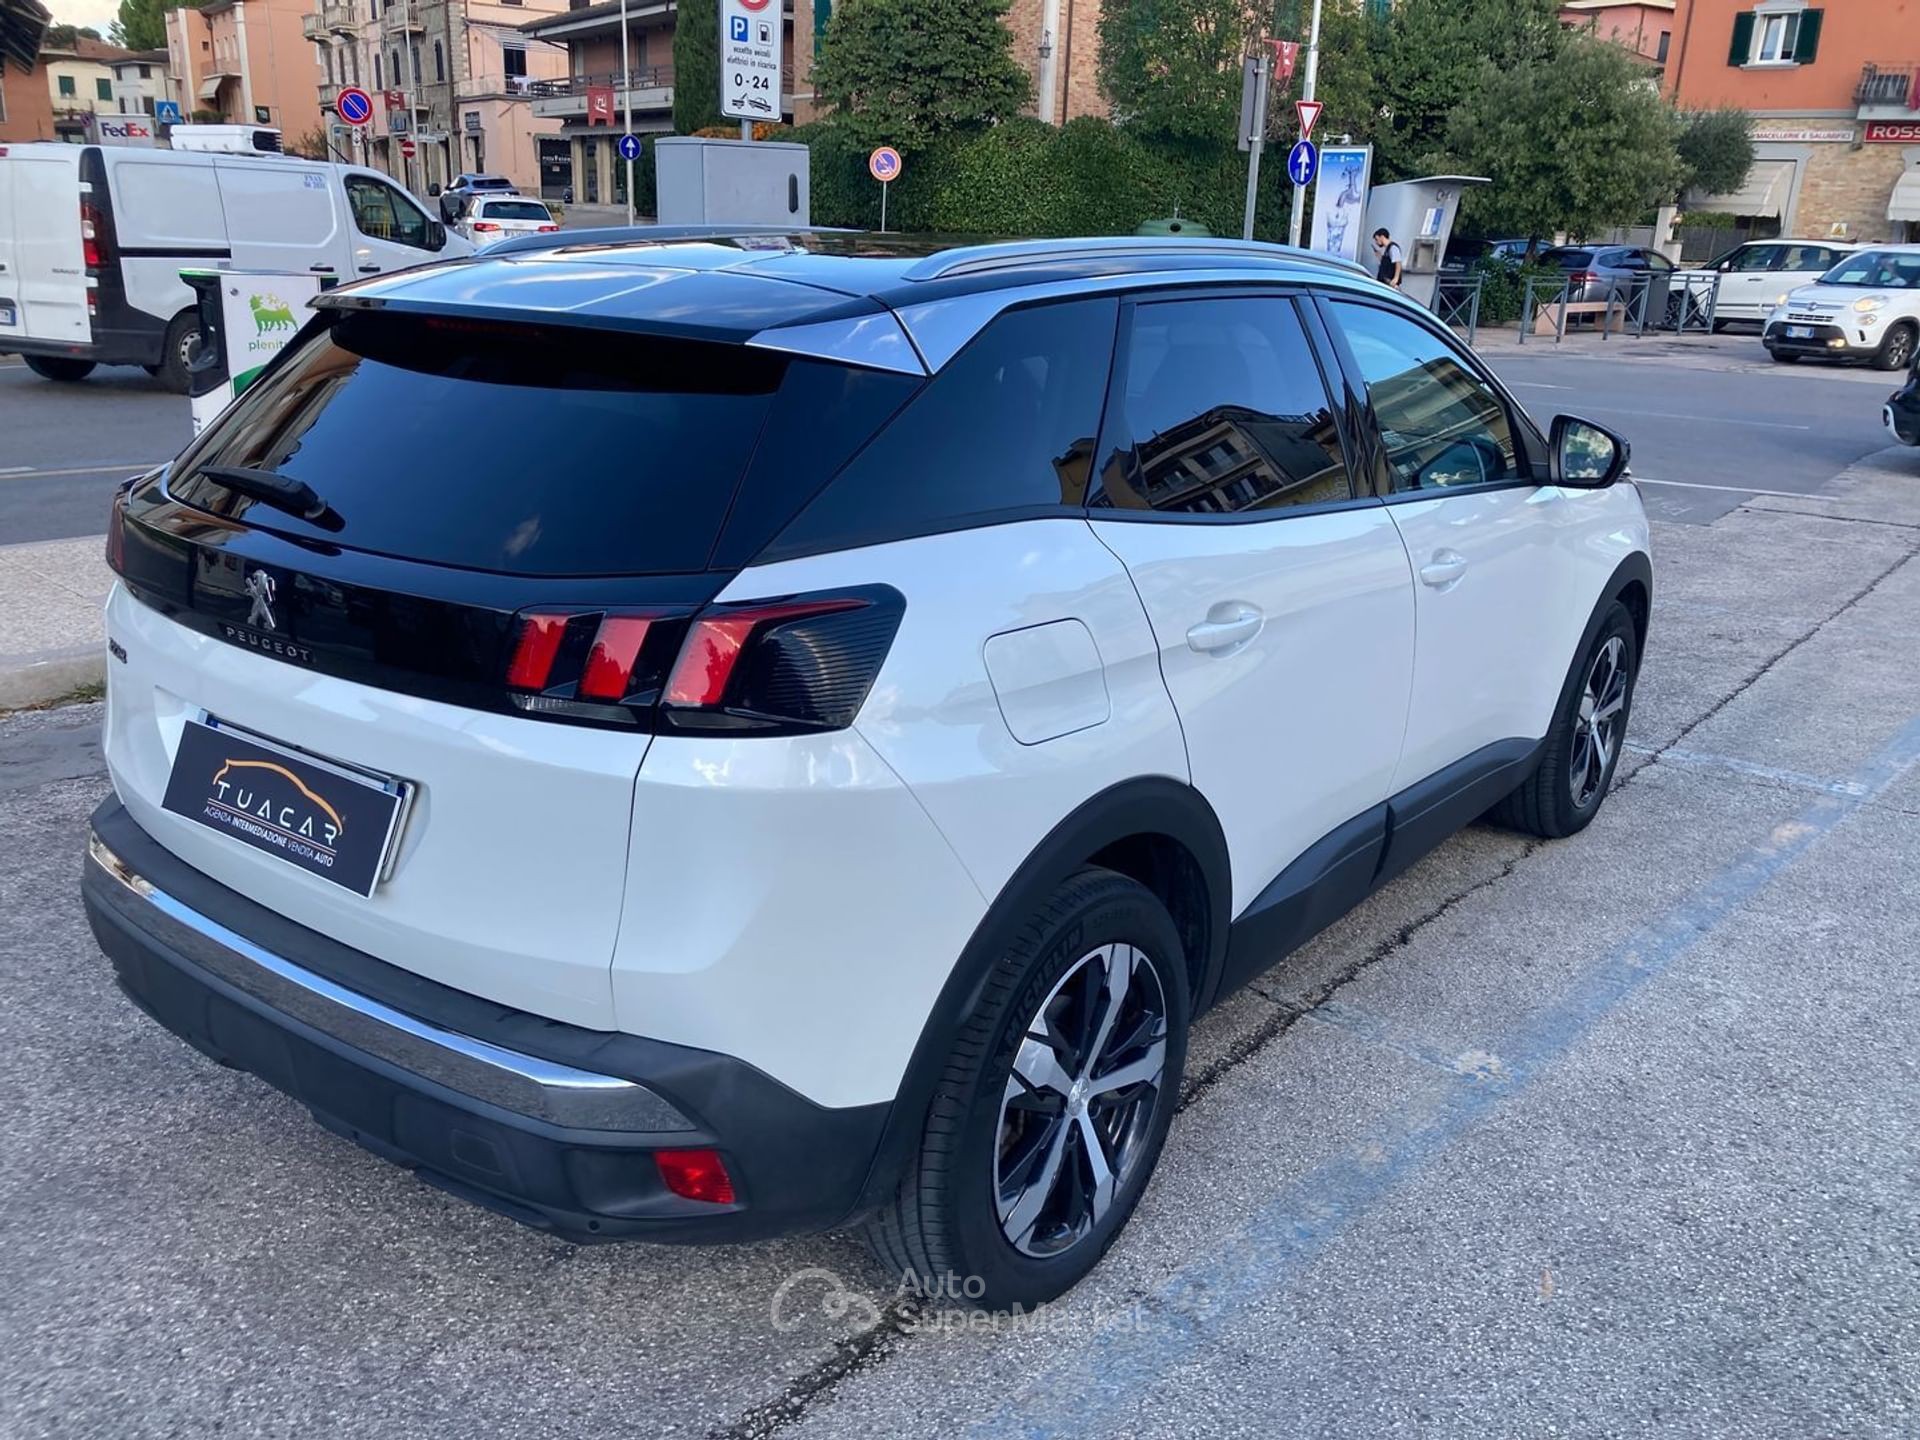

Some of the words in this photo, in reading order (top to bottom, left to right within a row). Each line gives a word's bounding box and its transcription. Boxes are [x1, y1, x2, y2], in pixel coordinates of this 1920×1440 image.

[734, 18, 745, 39] P
[101, 122, 149, 137] FedEx
[248, 339, 288, 352] plenit
[226, 626, 310, 661] PEUGEOT
[218, 780, 337, 845] TUACAR
[203, 806, 231, 823] AGENZIA
[231, 816, 288, 847] INTERMEDIAZIONE
[287, 840, 314, 859] VENDITA
[314, 852, 334, 867] AUTO
[1005, 920, 1085, 1044] MICHELIN
